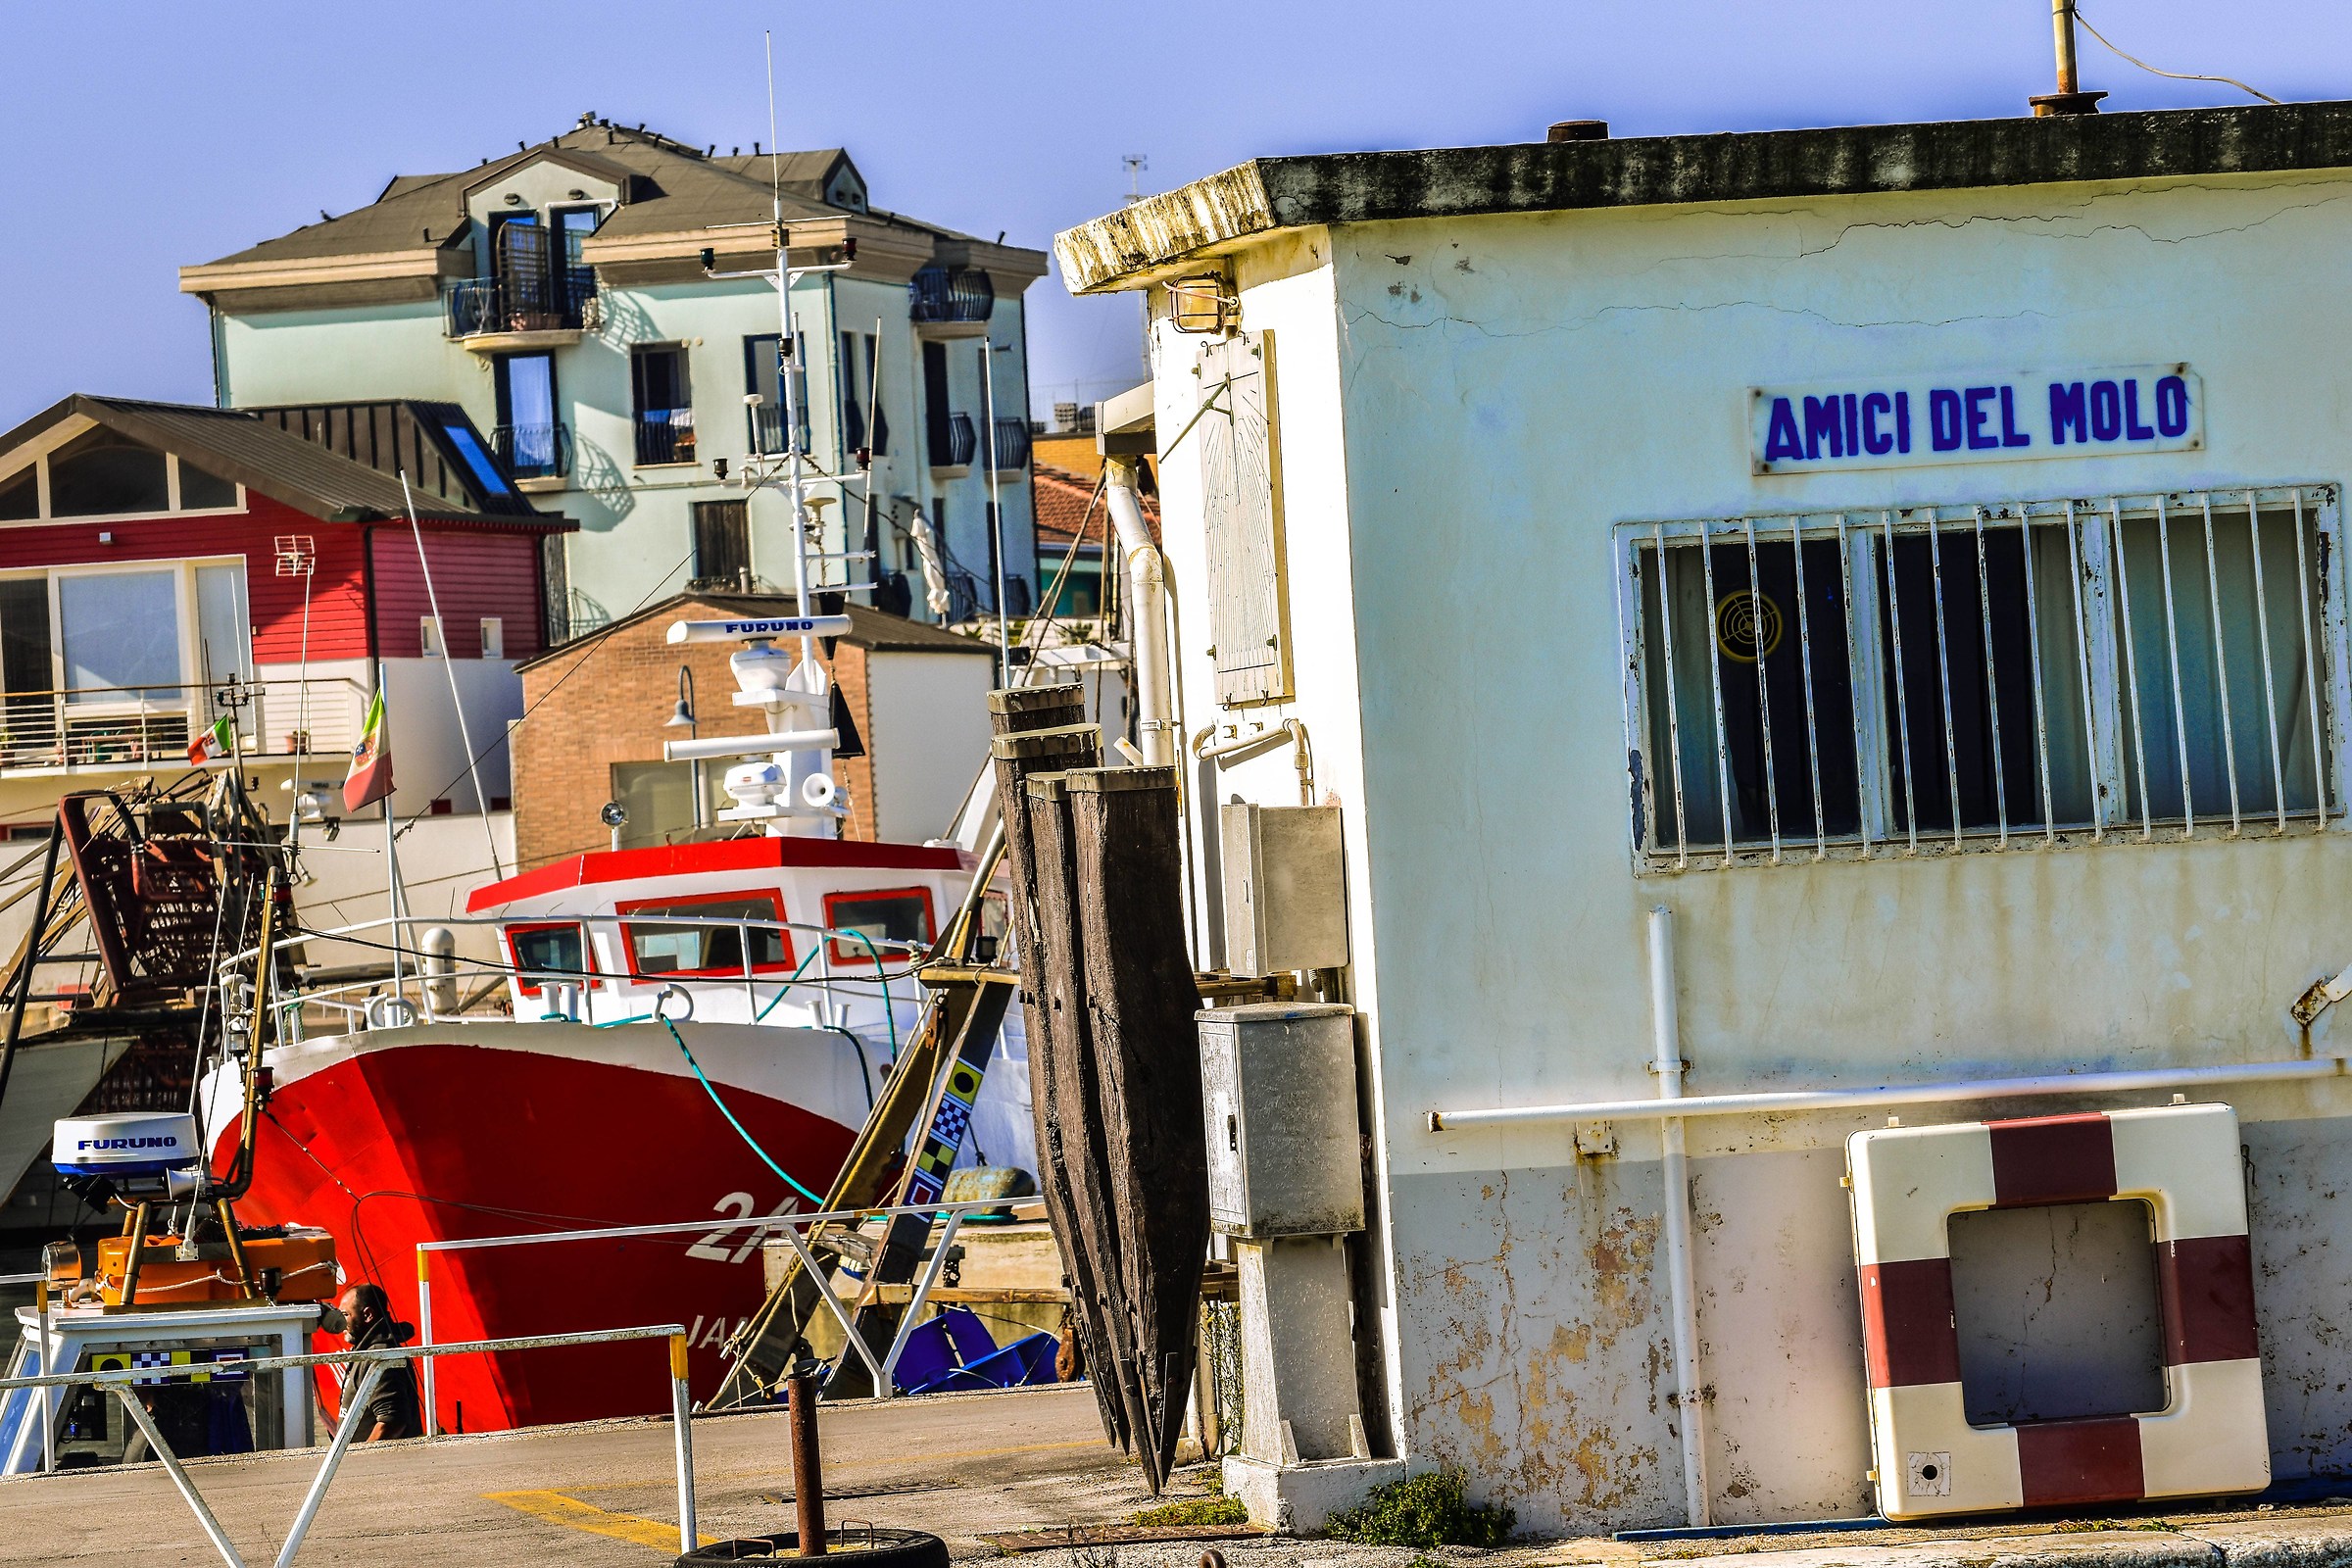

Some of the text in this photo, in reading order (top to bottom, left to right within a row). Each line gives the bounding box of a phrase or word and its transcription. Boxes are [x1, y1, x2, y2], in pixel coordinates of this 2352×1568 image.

[1765, 375, 2187, 462] AMICI DEL MOLO
[725, 620, 813, 633] FURUNO
[77, 1137, 177, 1150] FURUNO
